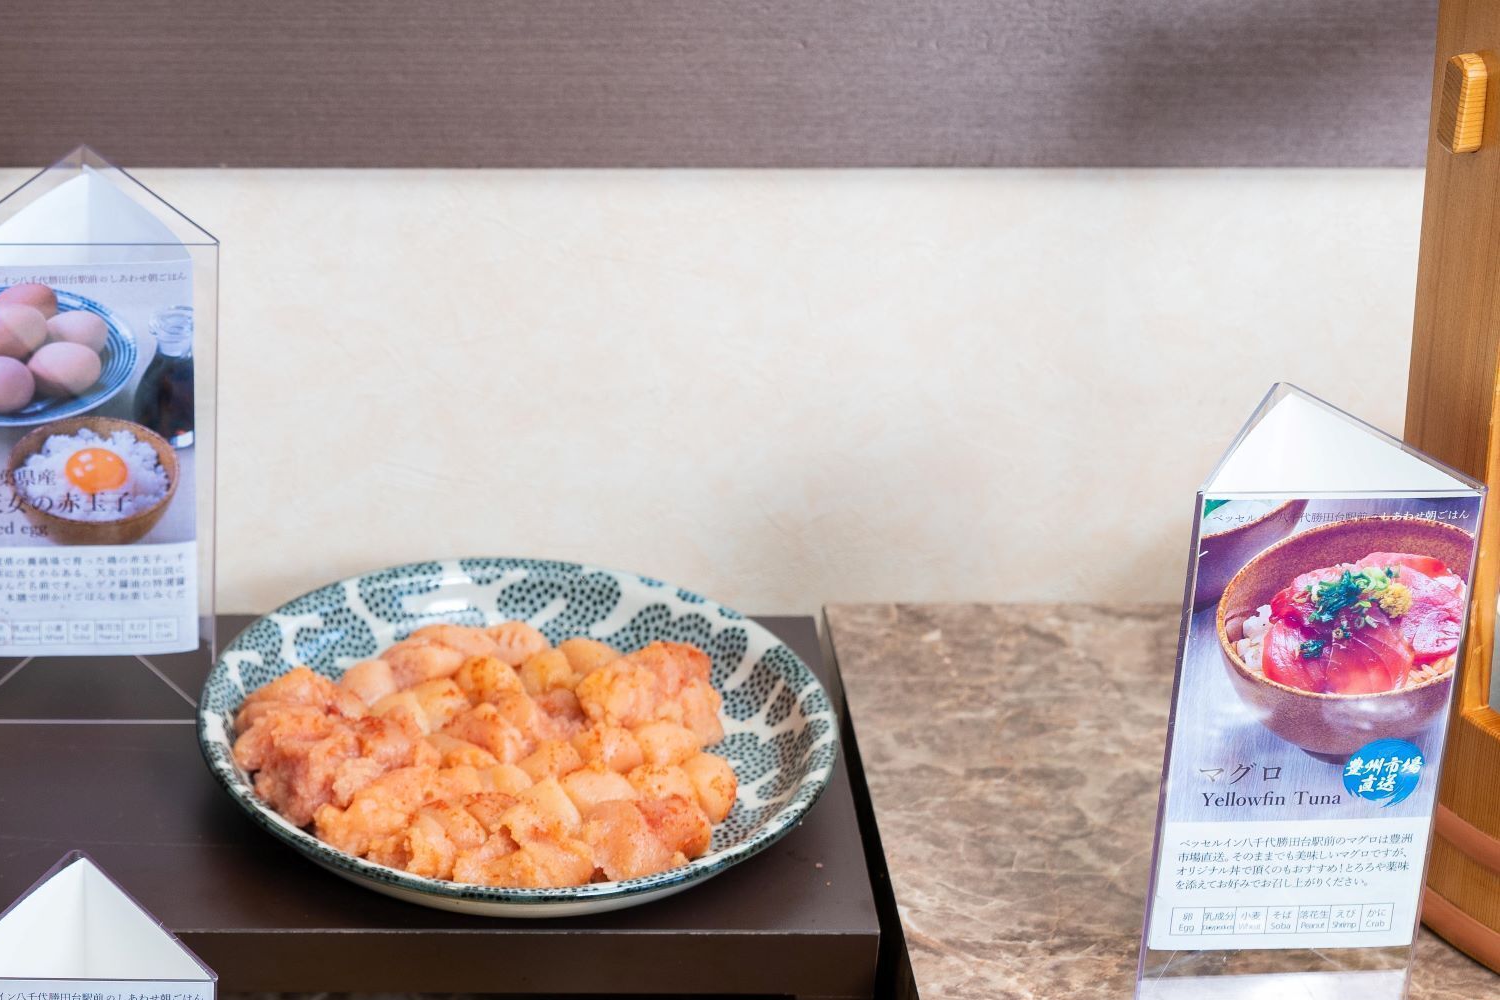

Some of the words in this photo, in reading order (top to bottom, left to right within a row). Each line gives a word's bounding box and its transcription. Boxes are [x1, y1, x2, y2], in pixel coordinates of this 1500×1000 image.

[20, 524, 49, 538] egg
[1199, 763, 1282, 784] マグロ
[1358, 773, 1398, 792] 直送
[1202, 791, 1285, 807] Yellowfin
[1295, 791, 1341, 806] Tuna
[1273, 910, 1292, 919] そば
[1366, 908, 1386, 917] かに
[1178, 924, 1195, 932] Egg
[1270, 922, 1291, 930] Soba
[1365, 919, 1385, 928] Crab
